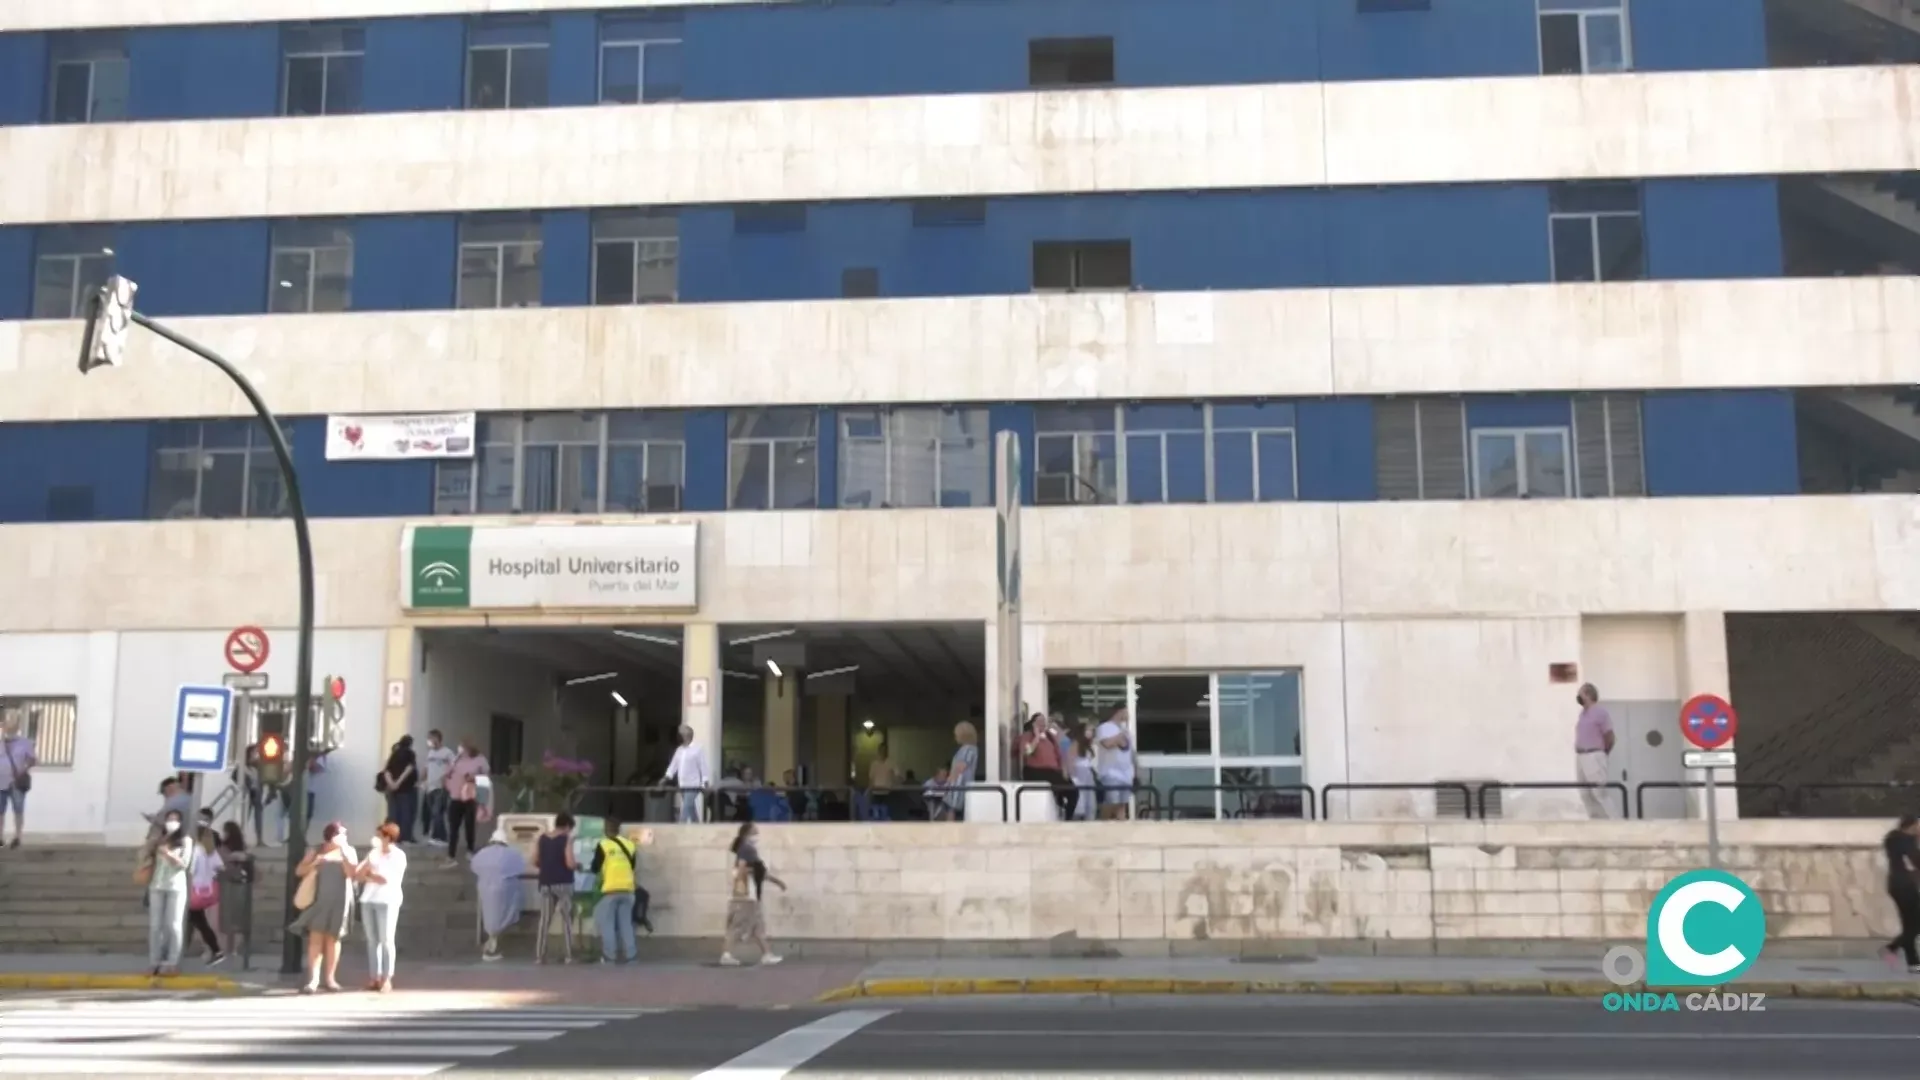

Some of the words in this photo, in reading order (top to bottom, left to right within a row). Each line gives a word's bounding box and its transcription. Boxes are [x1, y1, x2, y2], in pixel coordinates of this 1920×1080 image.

[489, 557, 561, 578] Hospital
[568, 556, 680, 575] Universitario
[589, 579, 629, 593] Puerta
[633, 579, 652, 592] del
[656, 578, 679, 591] Mar
